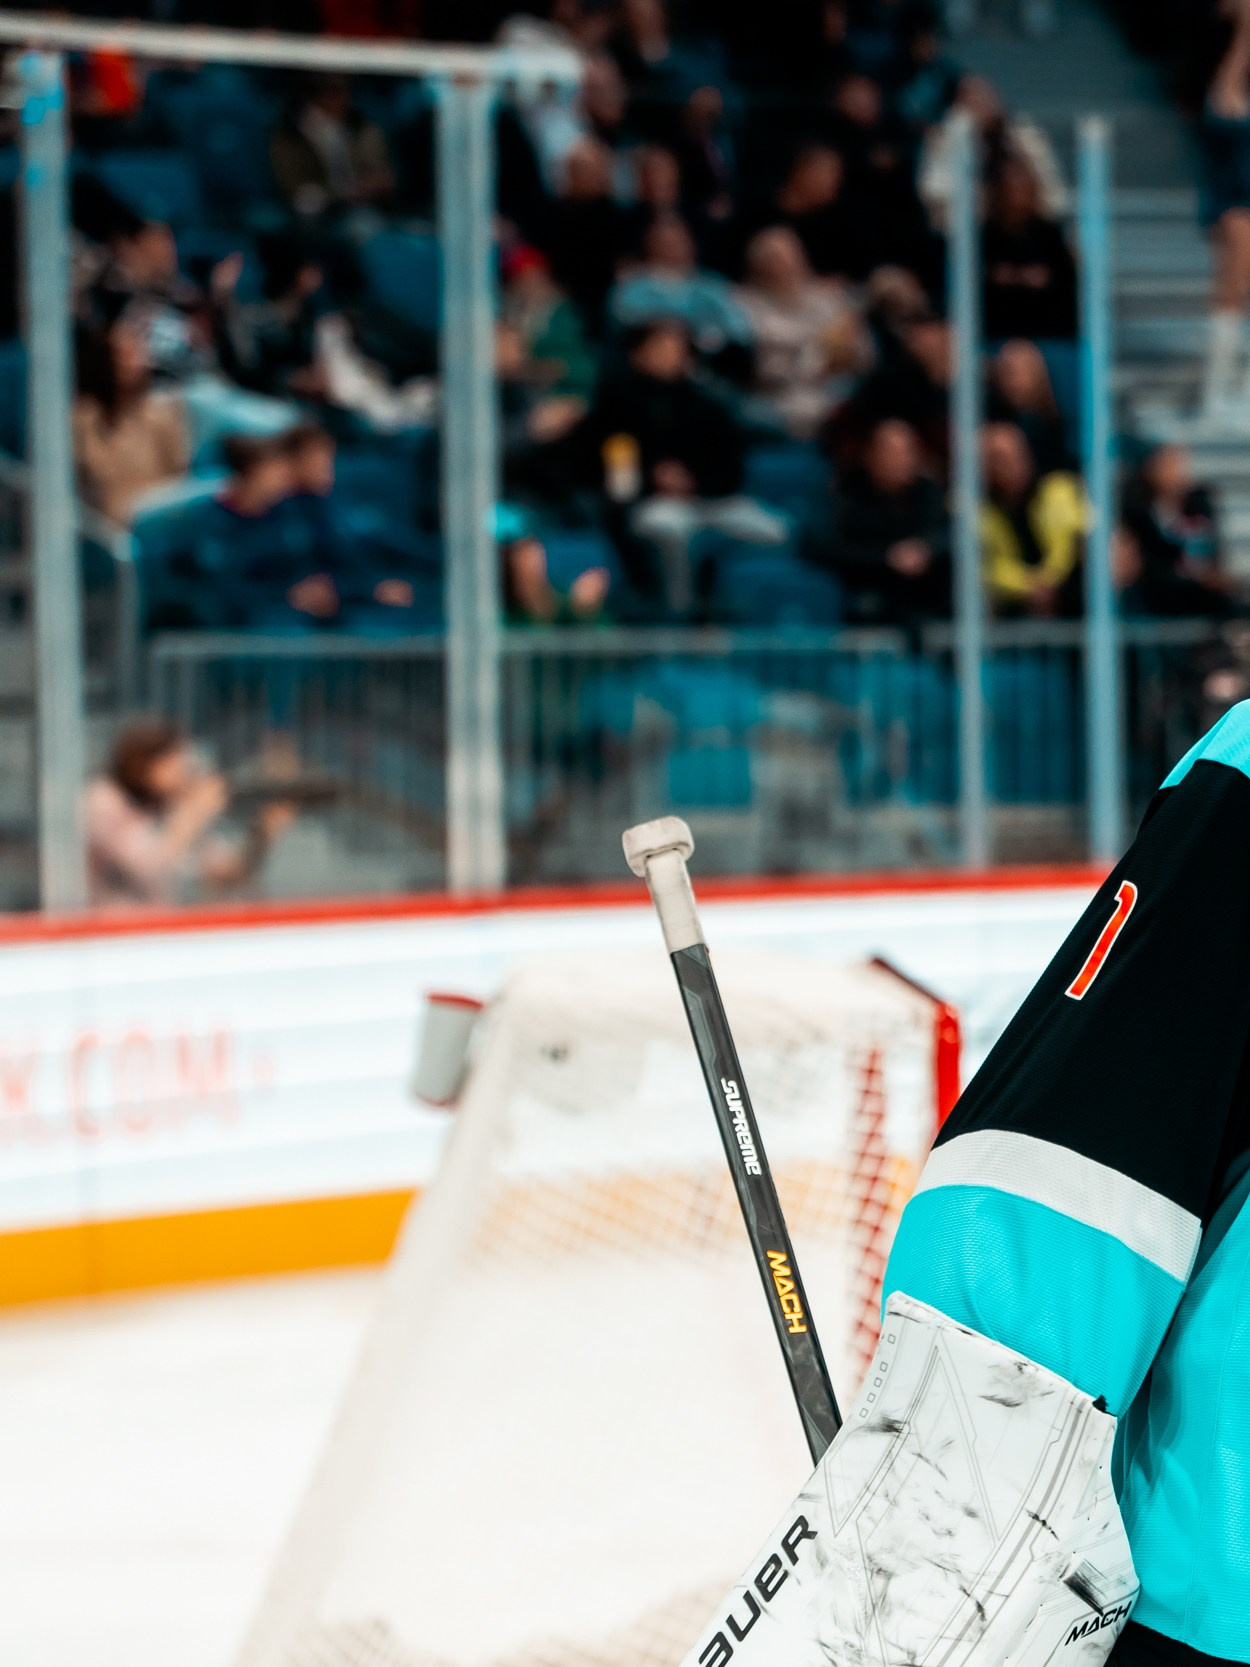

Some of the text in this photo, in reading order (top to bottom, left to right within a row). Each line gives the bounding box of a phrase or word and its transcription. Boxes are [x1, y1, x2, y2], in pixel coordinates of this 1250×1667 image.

[1064, 880, 1138, 1000] 1
[721, 1077, 762, 1176] SUPREME
[766, 1249, 808, 1334] MACH
[1065, 1600, 1132, 1646] MACH
